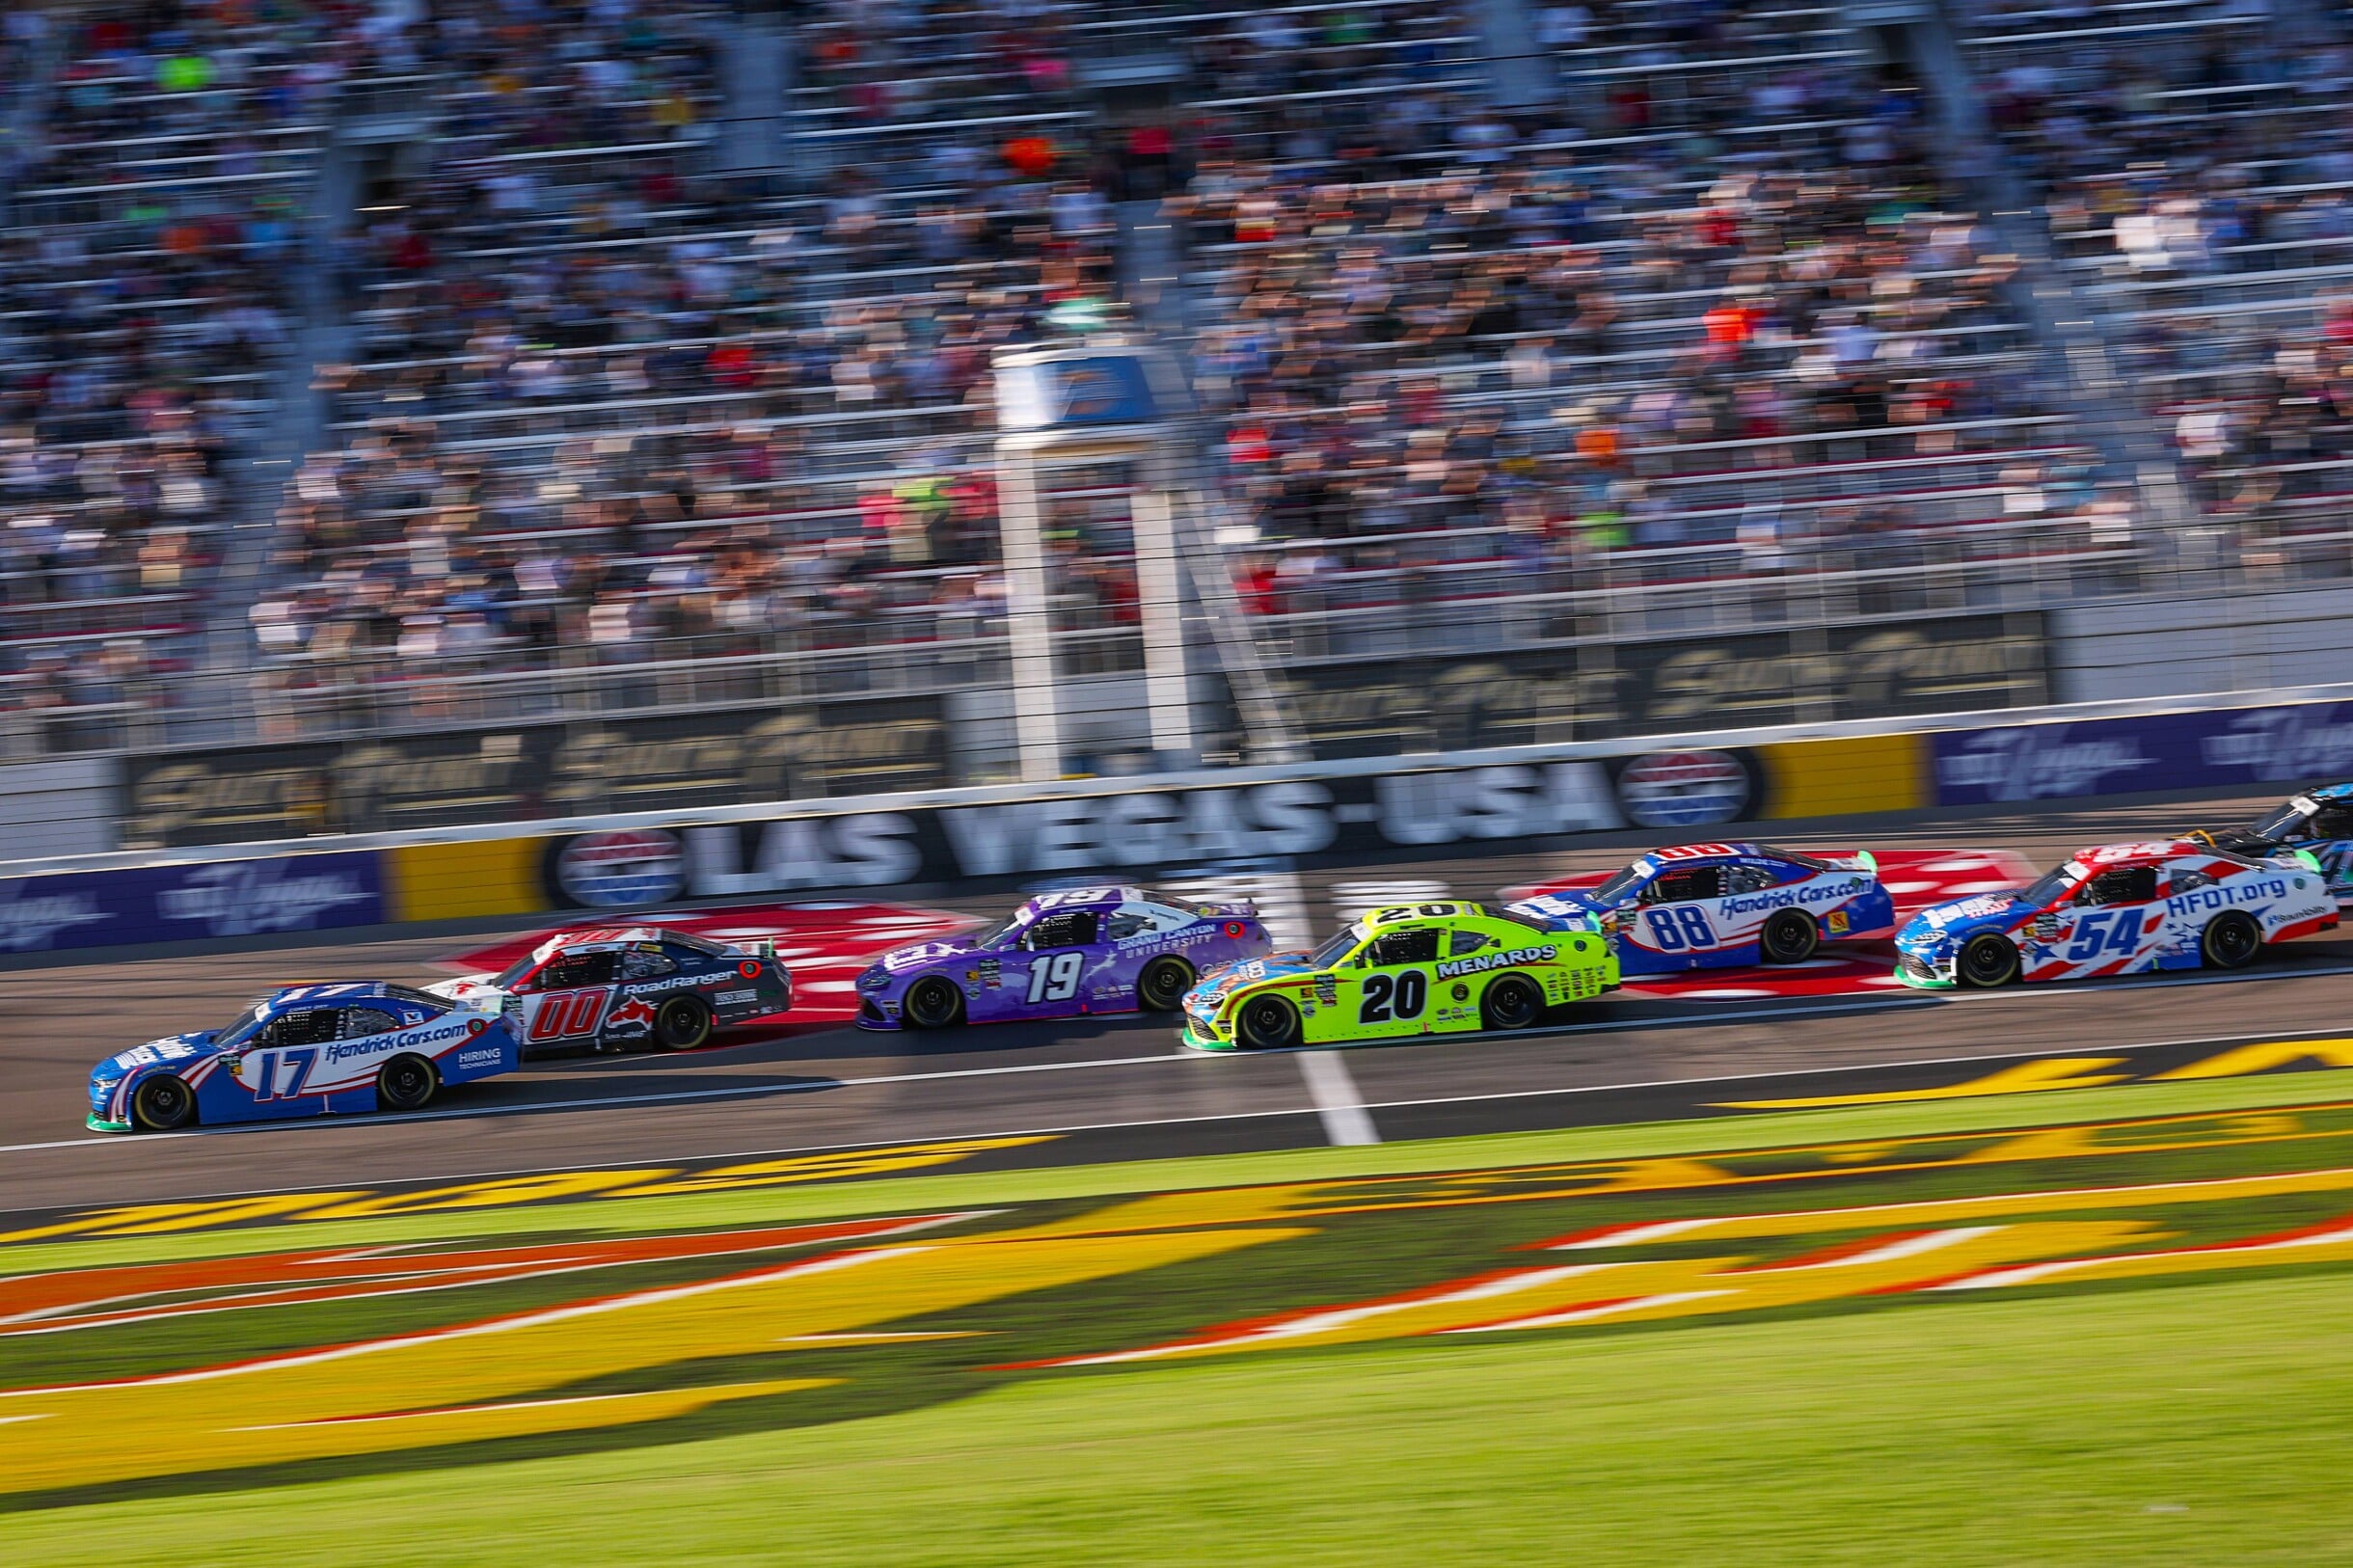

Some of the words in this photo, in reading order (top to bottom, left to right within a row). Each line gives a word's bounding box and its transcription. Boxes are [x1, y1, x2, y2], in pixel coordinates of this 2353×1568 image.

[683, 810, 924, 897] LAS
[1125, 933, 1214, 959] UNIVERSITY
[1643, 904, 1718, 952] 88
[2067, 908, 2146, 961] 54
[1025, 950, 1085, 1005] 19
[1437, 943, 1559, 981] MENARDS
[527, 987, 610, 1042] 00
[1358, 968, 1428, 1026] 20
[254, 1047, 319, 1103] 17
[458, 1048, 502, 1064] HIRING
